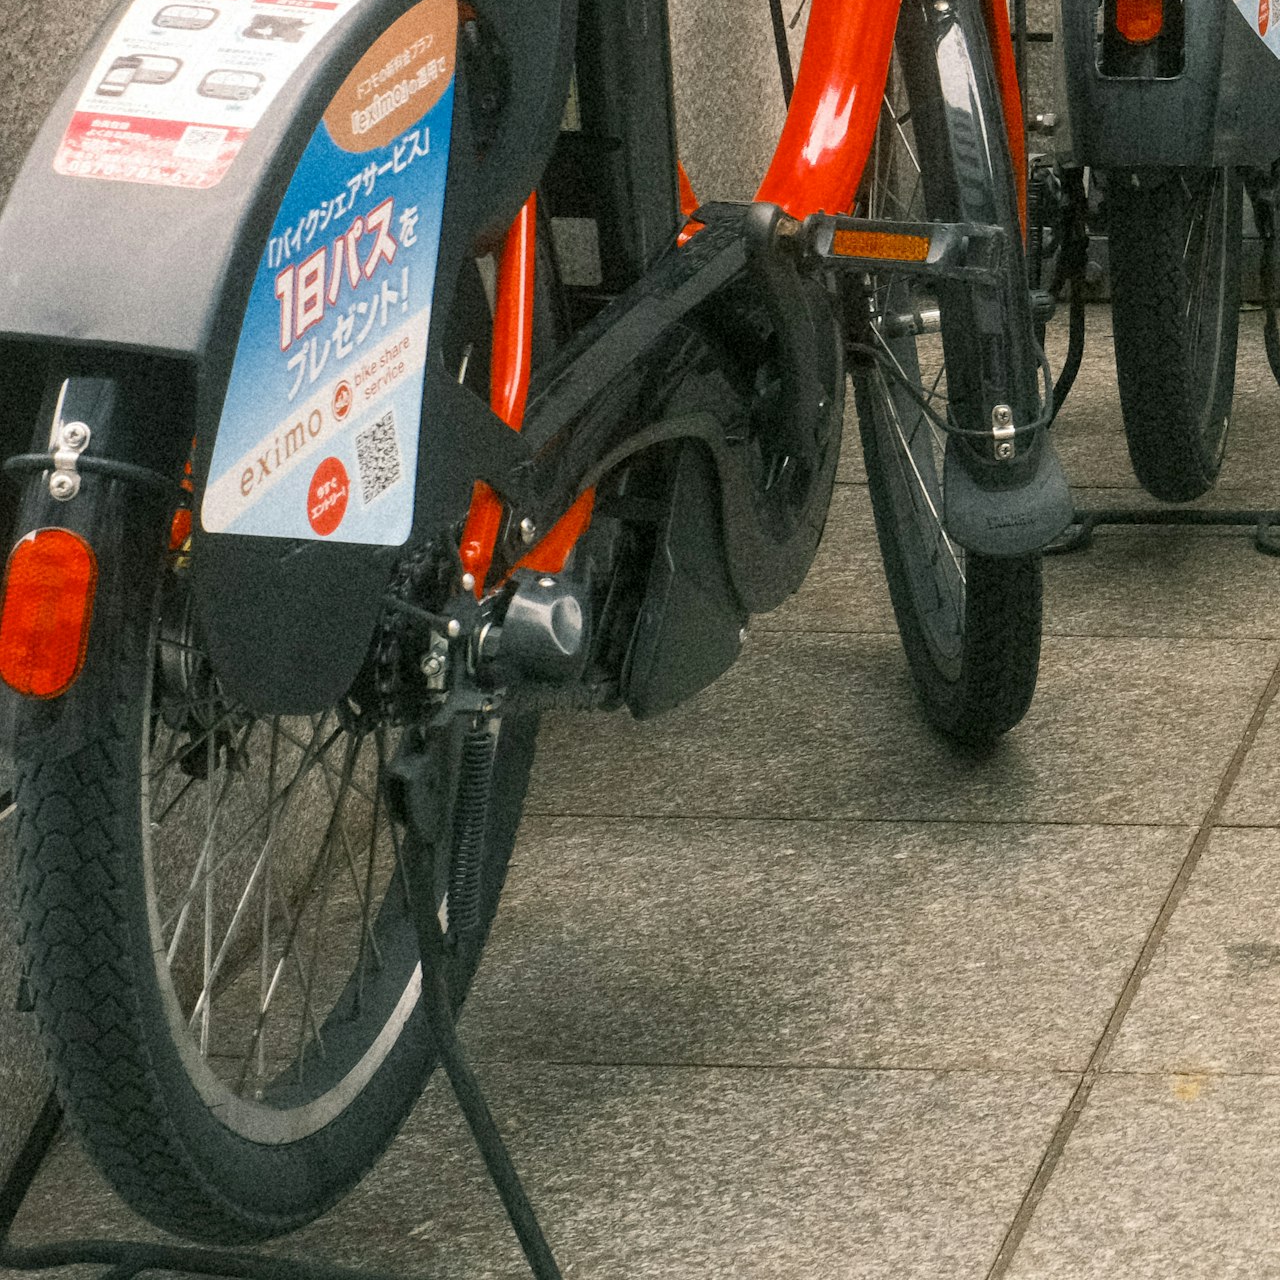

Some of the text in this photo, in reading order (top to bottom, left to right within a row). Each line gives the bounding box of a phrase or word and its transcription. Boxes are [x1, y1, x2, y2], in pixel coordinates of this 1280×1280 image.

[268, 127, 430, 269] 「バイクシェアサービス」
[287, 266, 410, 402] プレゼント!
[354, 336, 411, 387] bike share
[364, 360, 406, 400] service
[240, 409, 322, 497] eximo
